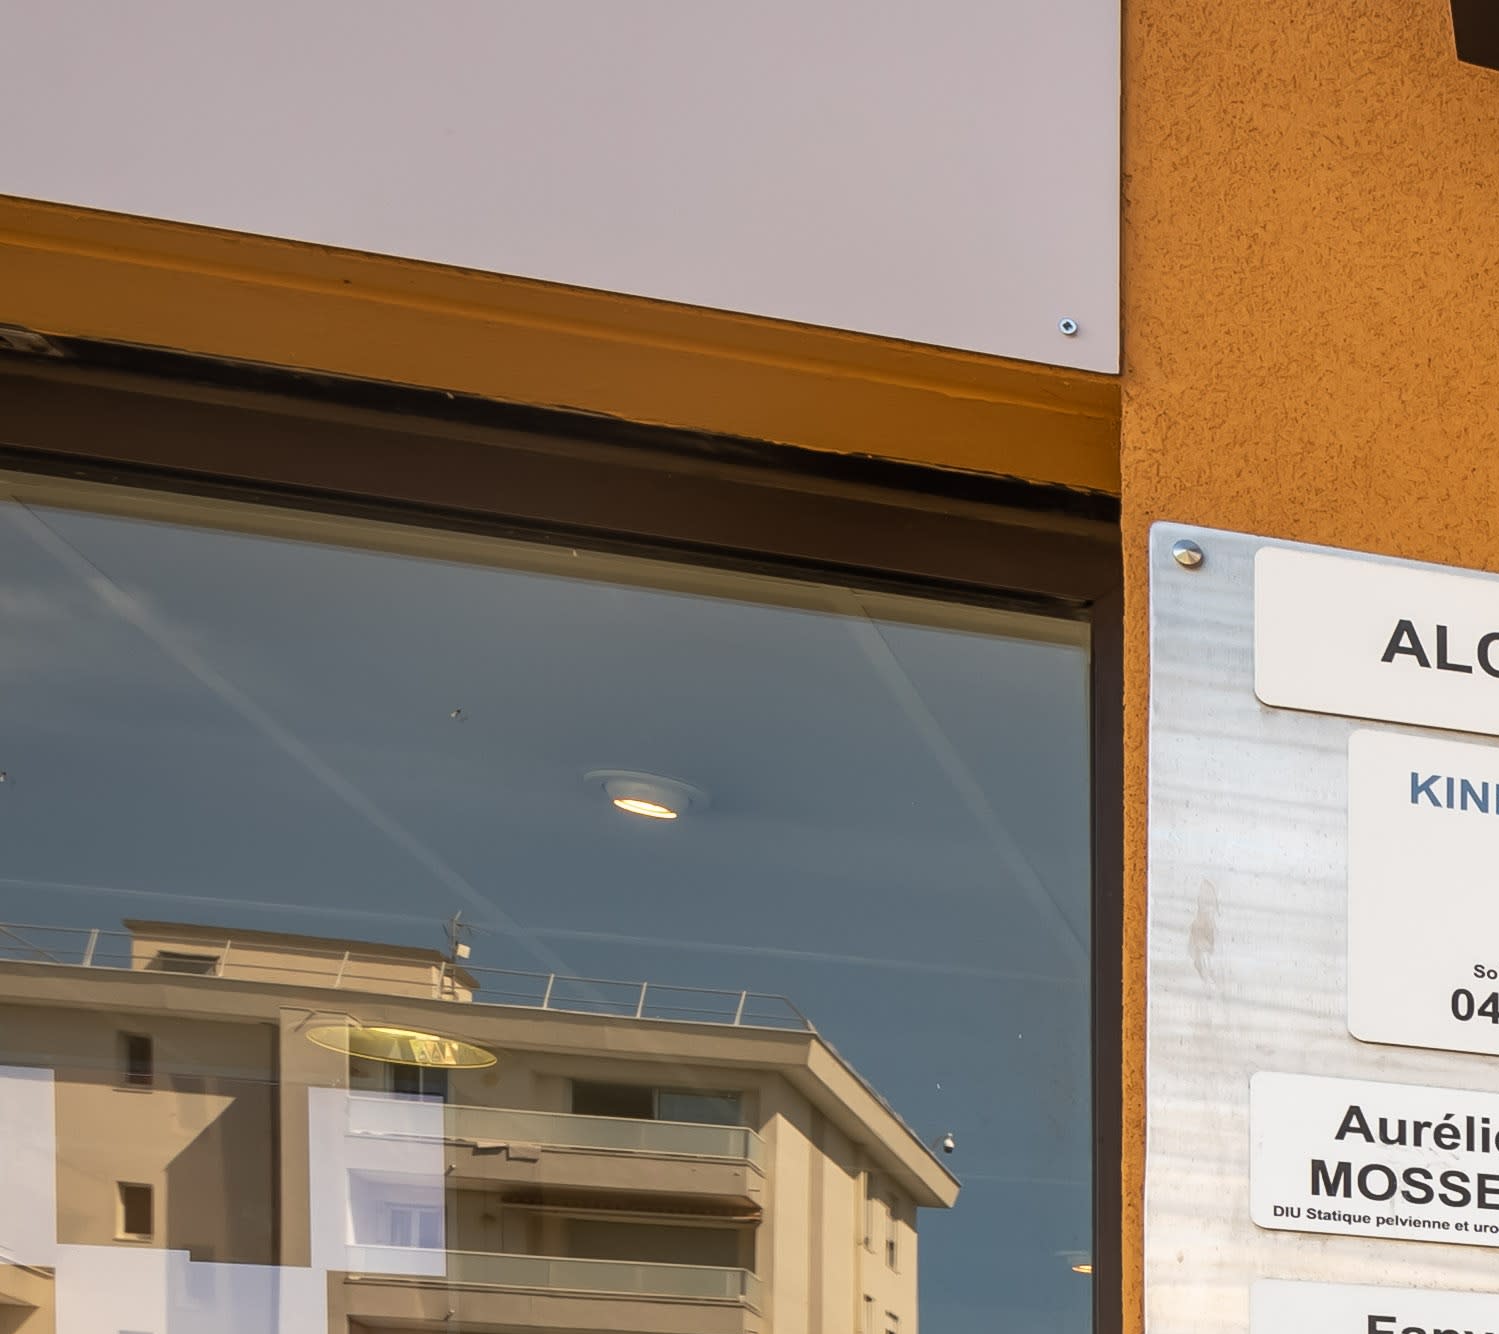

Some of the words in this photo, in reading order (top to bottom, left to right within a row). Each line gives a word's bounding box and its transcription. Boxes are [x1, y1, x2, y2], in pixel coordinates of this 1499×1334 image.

[1274, 1205, 1300, 1218] DIU
[1307, 1208, 1371, 1225] Statique
[1376, 1215, 1450, 1230] pelvienne
[1455, 1222, 1469, 1231] et
